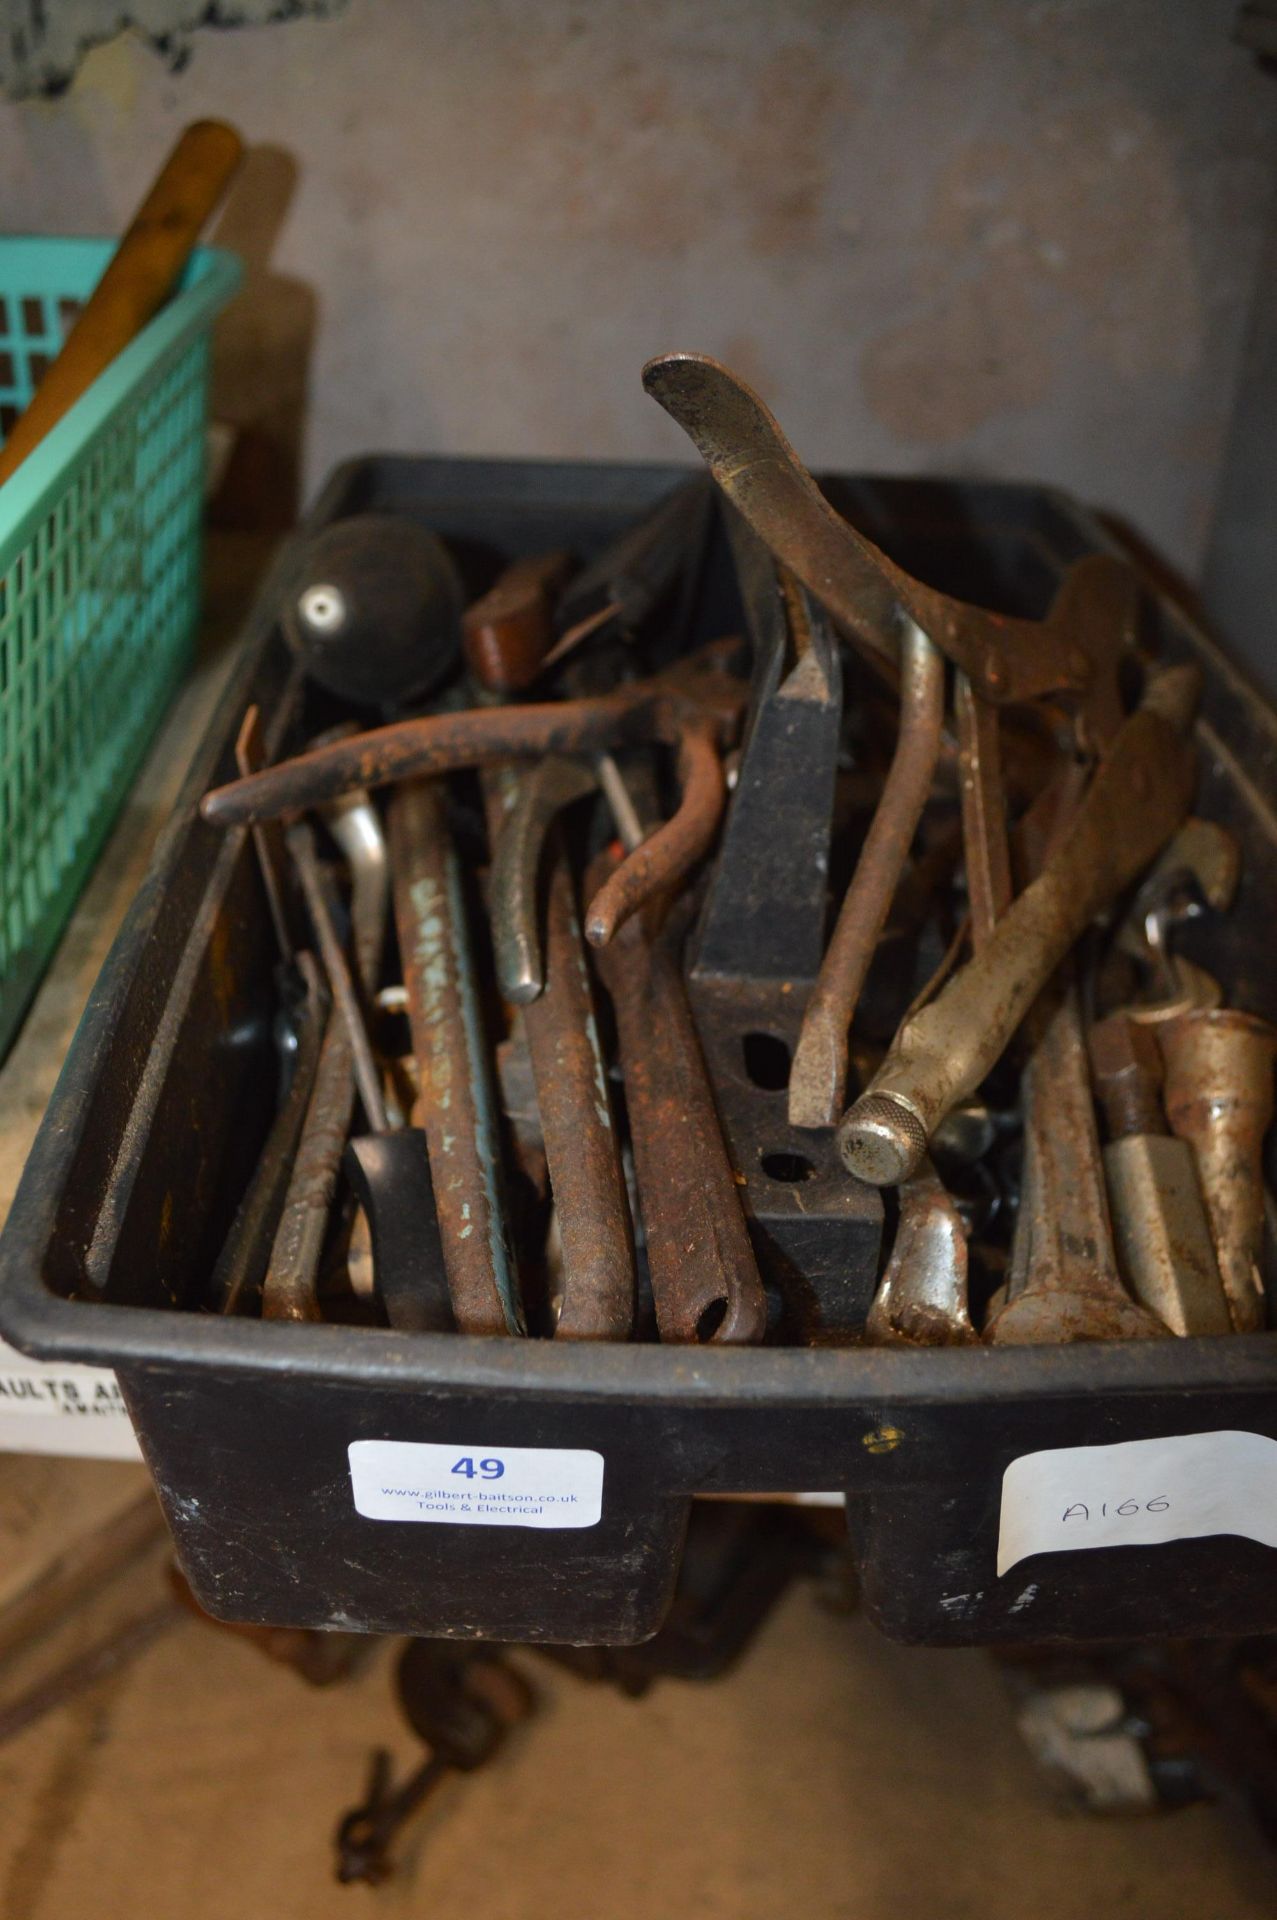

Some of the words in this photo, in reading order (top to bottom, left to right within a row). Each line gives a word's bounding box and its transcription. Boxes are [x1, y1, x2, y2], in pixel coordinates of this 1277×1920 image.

[451, 1457, 505, 1479] 49
[381, 1487, 578, 1503] www.gilbert-baitson.co.uk
[418, 1501, 455, 1511] Tools
[460, 1503, 472, 1512] &
[477, 1503, 543, 1514] Electrical
[1062, 1495, 1170, 1521] A166
